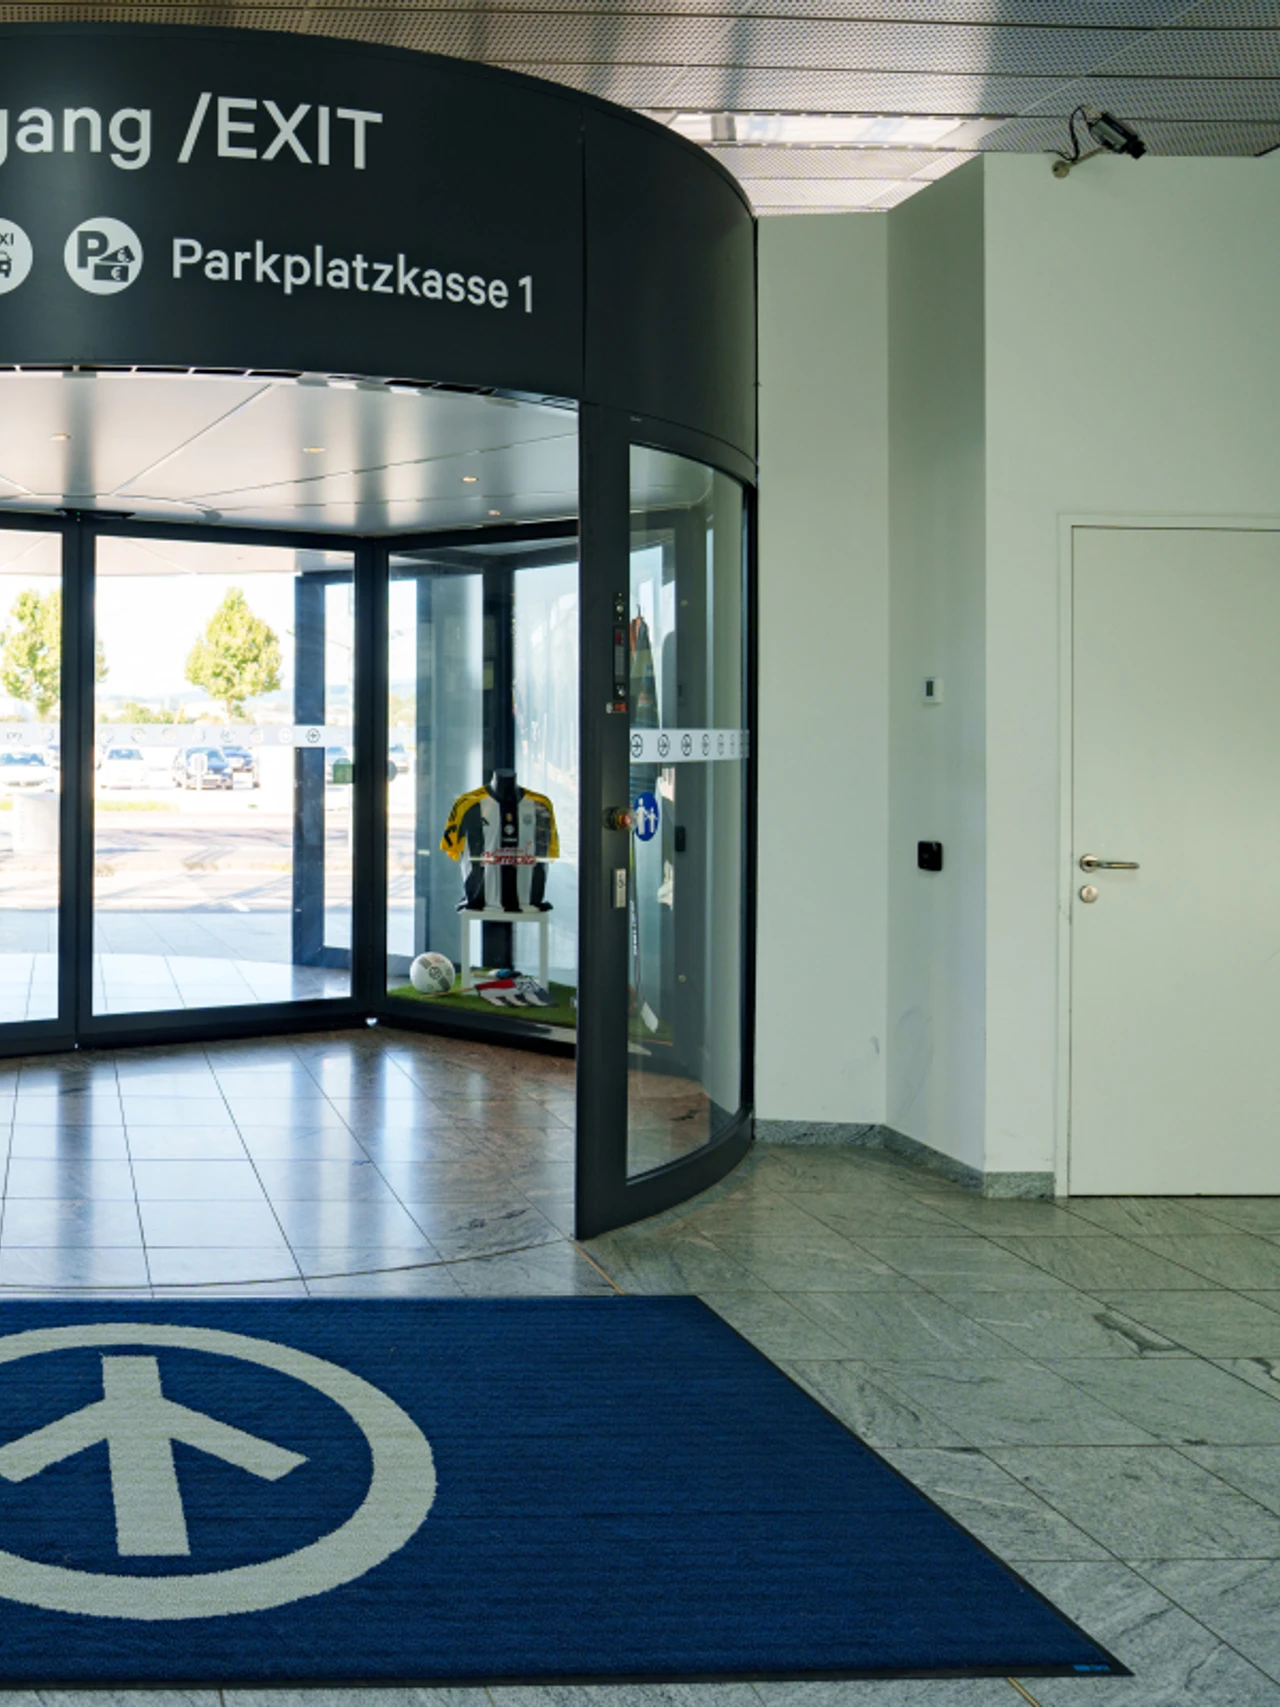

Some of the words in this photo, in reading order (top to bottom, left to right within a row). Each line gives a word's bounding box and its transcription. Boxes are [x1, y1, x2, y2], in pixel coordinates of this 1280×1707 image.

[177, 92, 383, 170] /EXIT
[172, 238, 509, 309] Parkplatzkasse
[518, 275, 532, 313] 1
